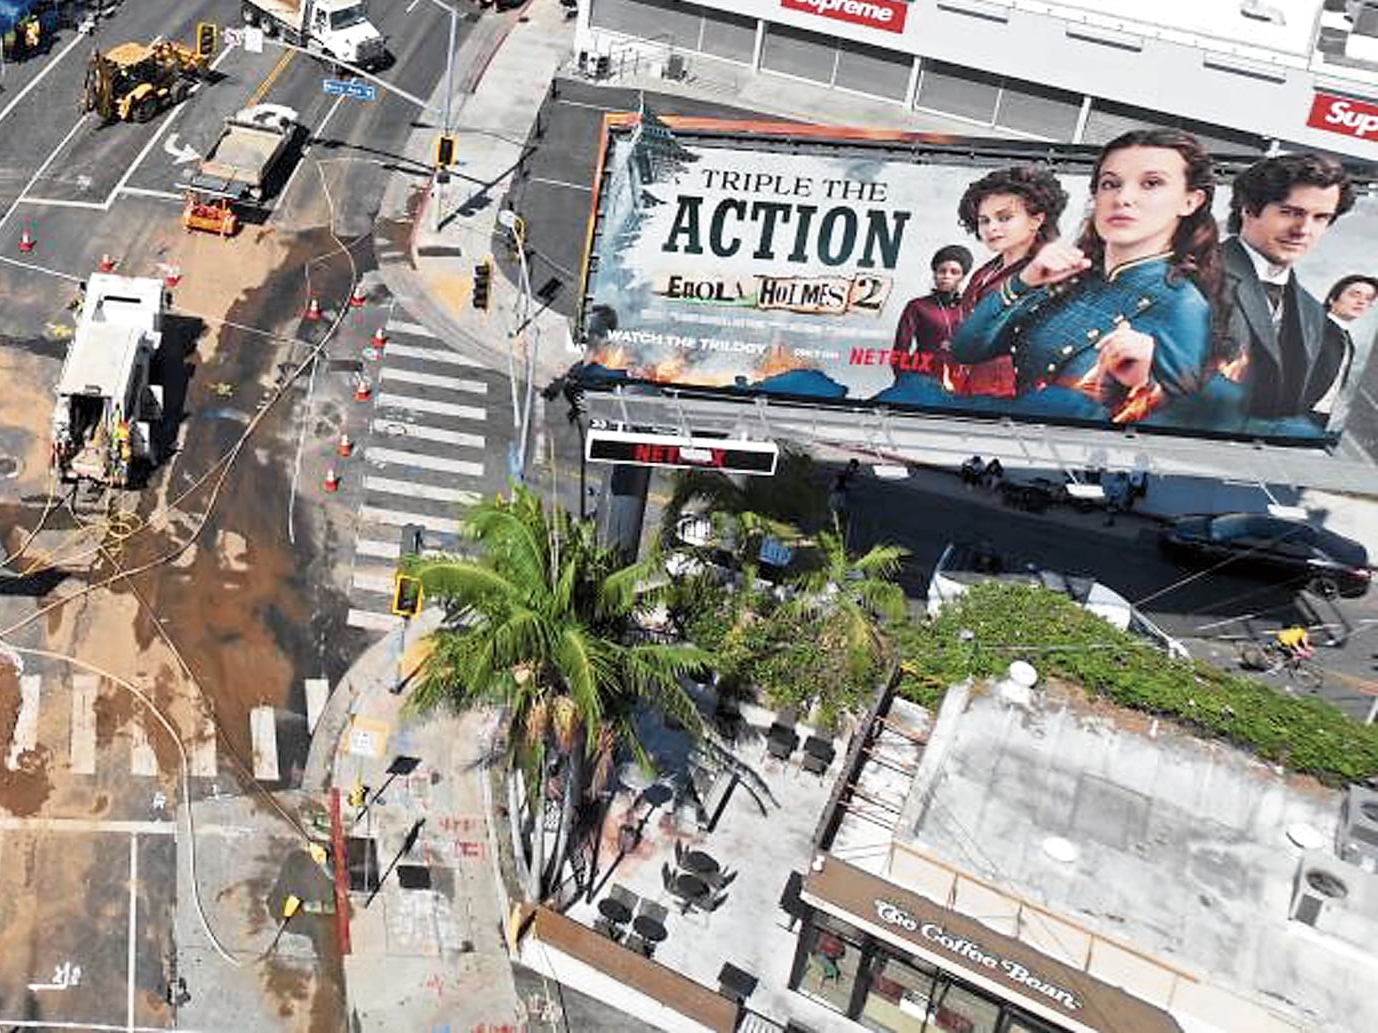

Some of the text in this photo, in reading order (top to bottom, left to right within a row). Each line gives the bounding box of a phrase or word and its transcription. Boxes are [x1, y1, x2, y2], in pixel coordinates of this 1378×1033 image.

[702, 169, 888, 202] TRIPLE THE
[662, 195, 911, 269] ACTION
[760, 279, 844, 308] HOLMES
[855, 277, 883, 309] 2
[607, 329, 767, 355] WATCH THE TRILOGY
[849, 346, 935, 372] NETFLIX
[634, 443, 725, 469] NETX
[873, 899, 1084, 1010] The Coffee Bean
